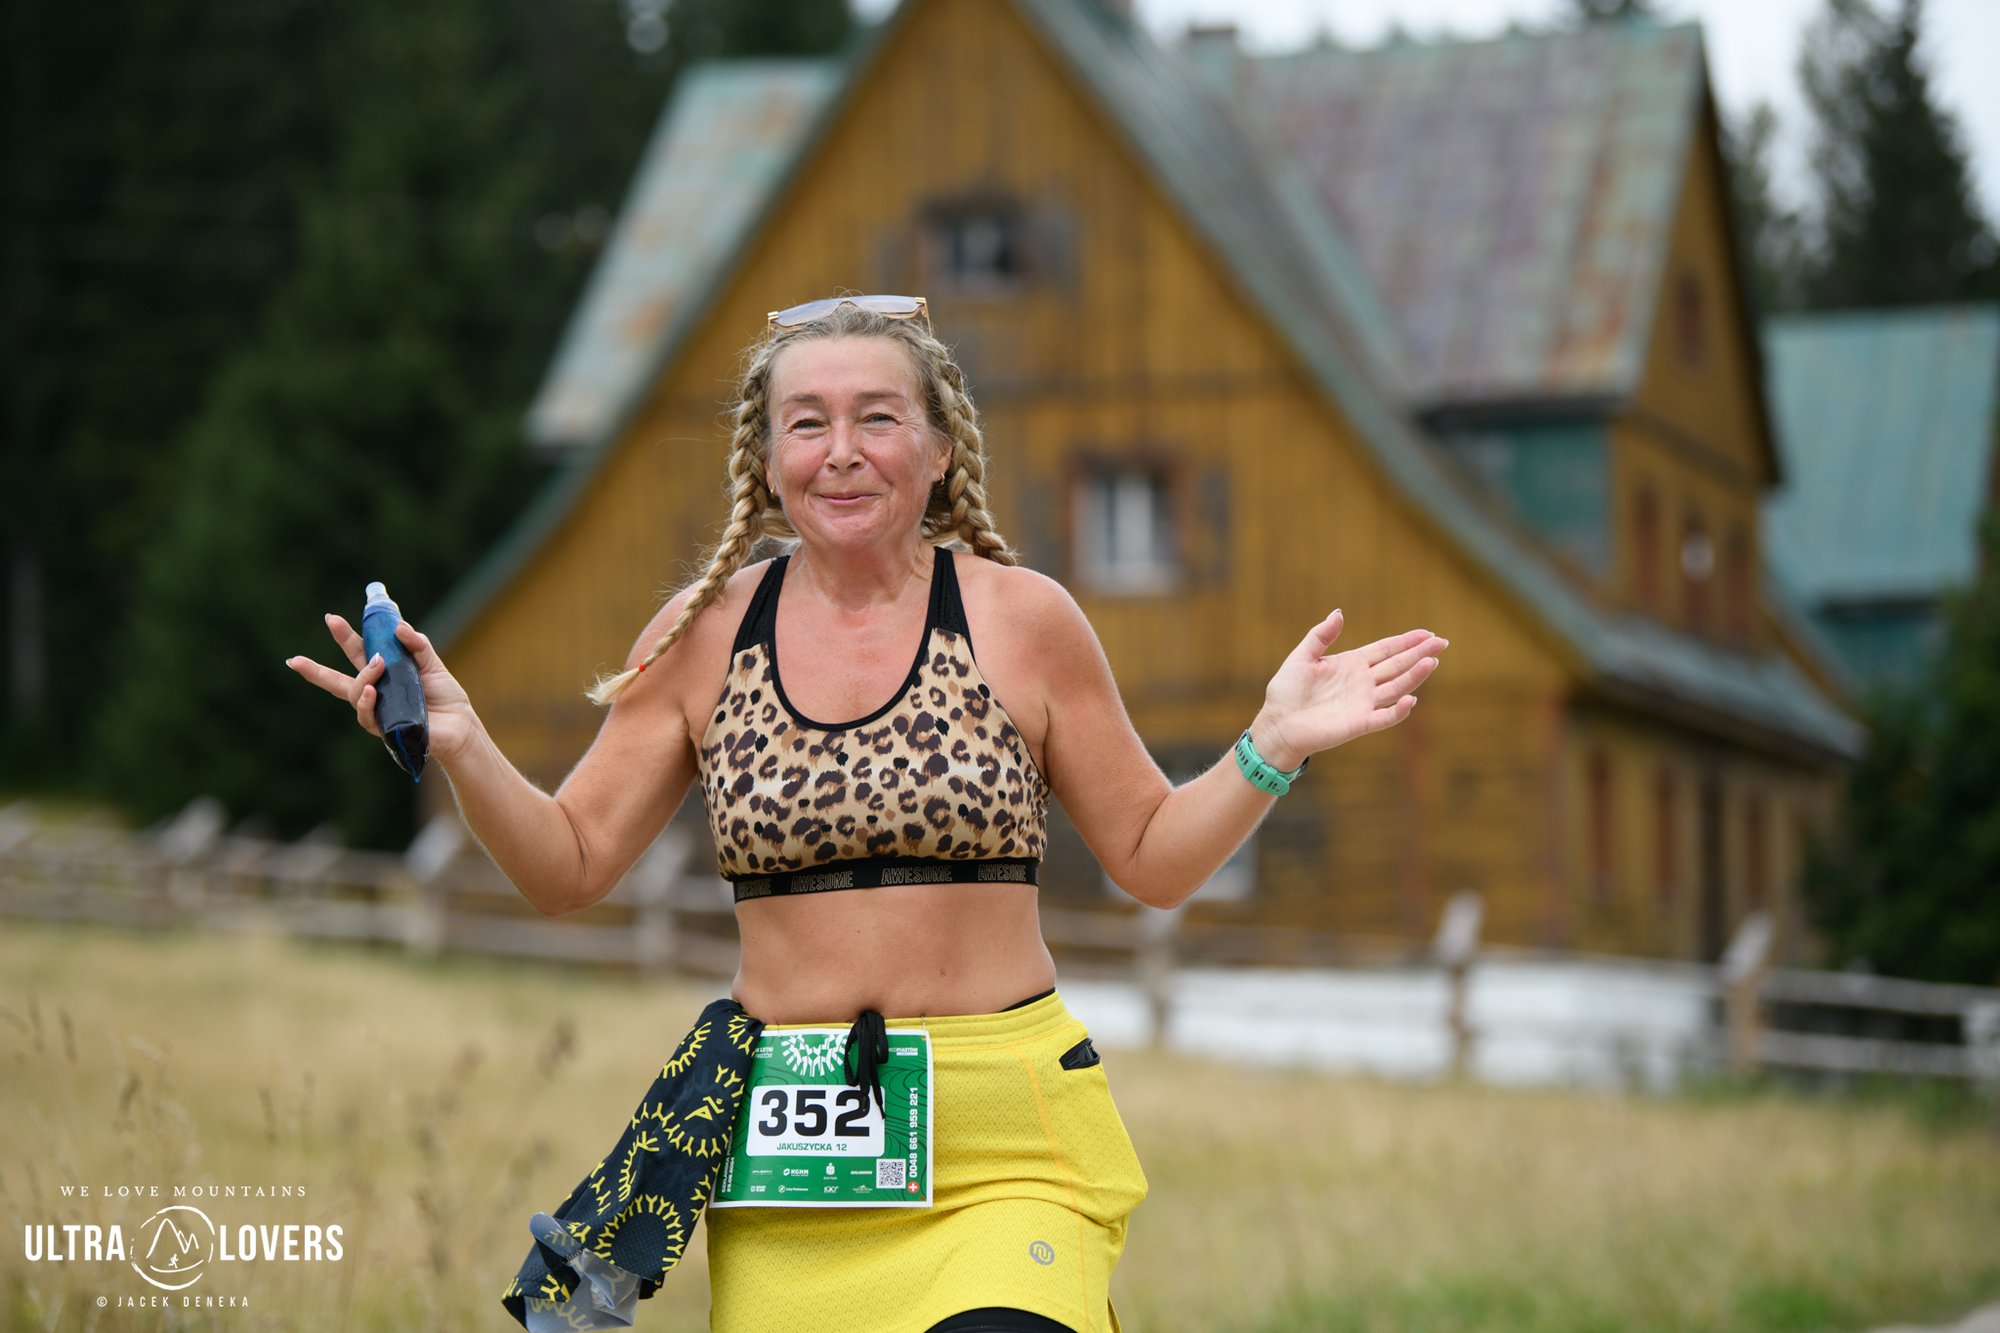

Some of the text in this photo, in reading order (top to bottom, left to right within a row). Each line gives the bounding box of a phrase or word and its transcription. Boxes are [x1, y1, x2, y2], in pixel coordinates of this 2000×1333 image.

[790, 870, 854, 893] AWESOME
[881, 865, 953, 885] AWESOME
[977, 863, 1027, 882] AWESOME
[758, 1089, 871, 1137] 352
[909, 1087, 919, 1178] 0048 661 959 221
[776, 1142, 847, 1152] JAKUSZYCKA 12
